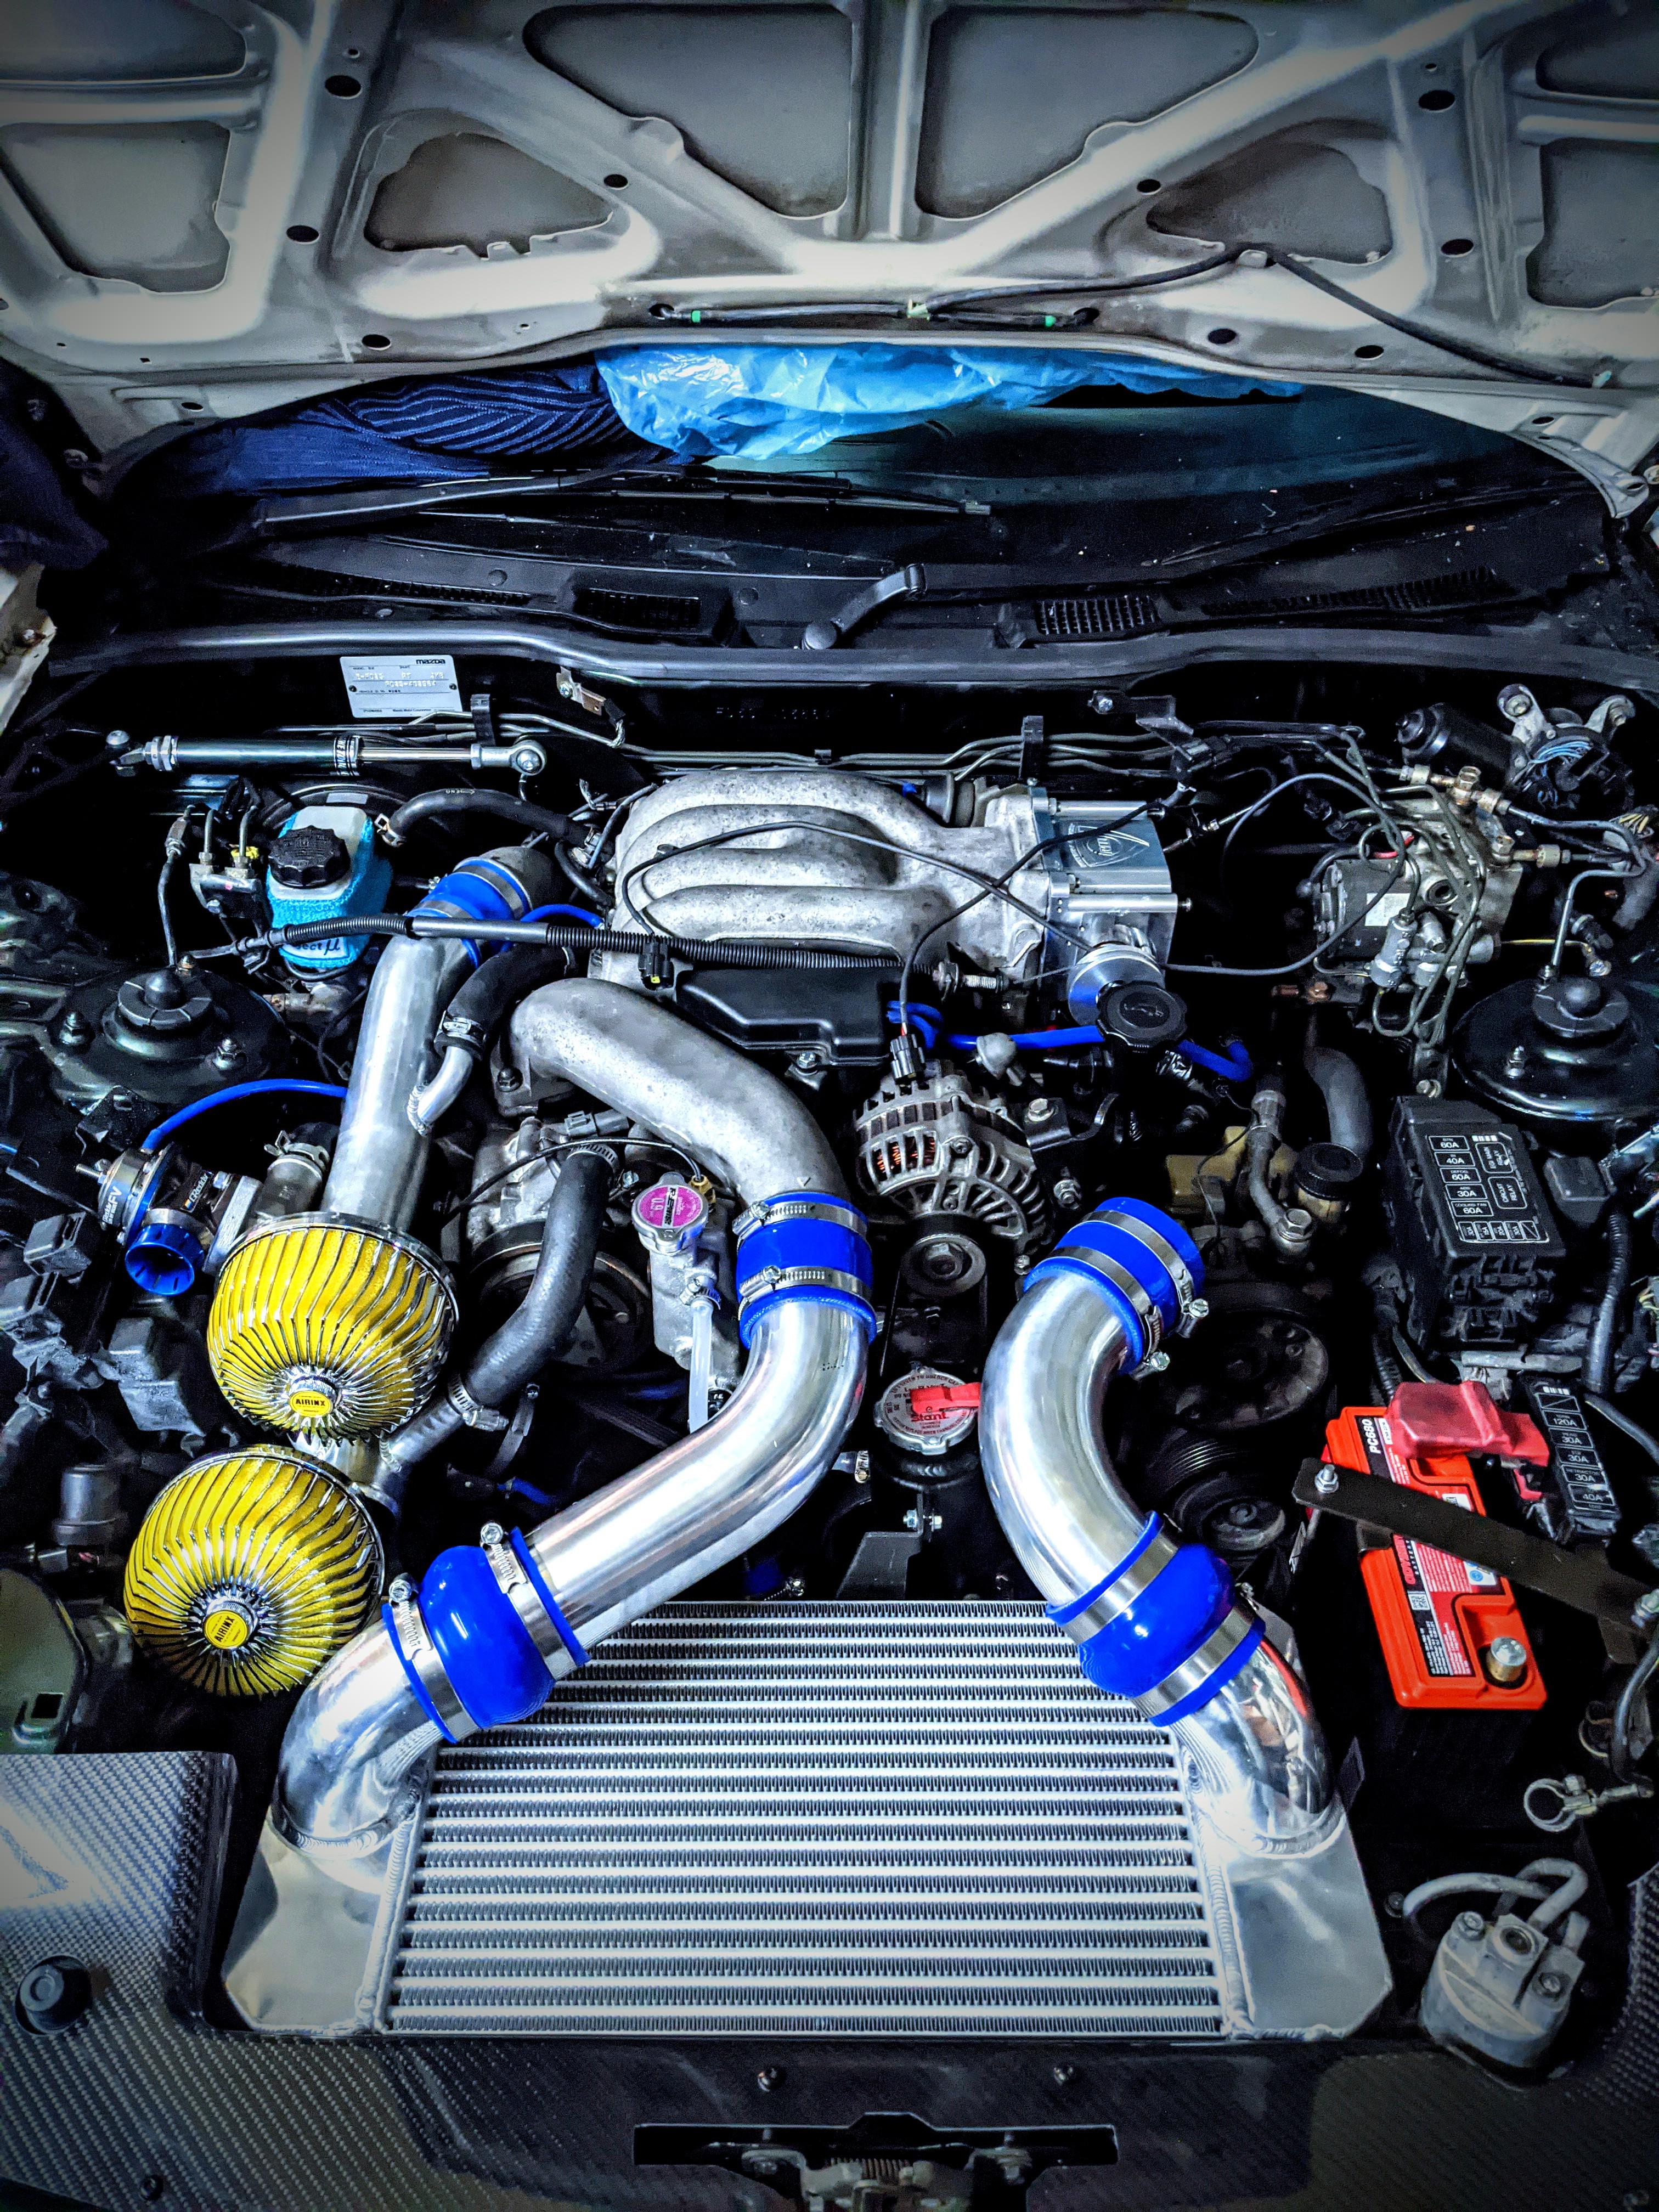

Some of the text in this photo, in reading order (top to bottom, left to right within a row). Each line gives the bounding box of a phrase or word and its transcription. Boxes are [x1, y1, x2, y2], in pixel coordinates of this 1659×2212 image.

[1553, 1418, 1578, 1427] 120A
[1362, 1419, 1381, 1454] PC680
[1562, 1436, 1582, 1444] 30A
[1567, 1454, 1589, 1463] 30A
[1575, 1474, 1596, 1482] 30A
[214, 1616, 235, 1643] AIRINX
